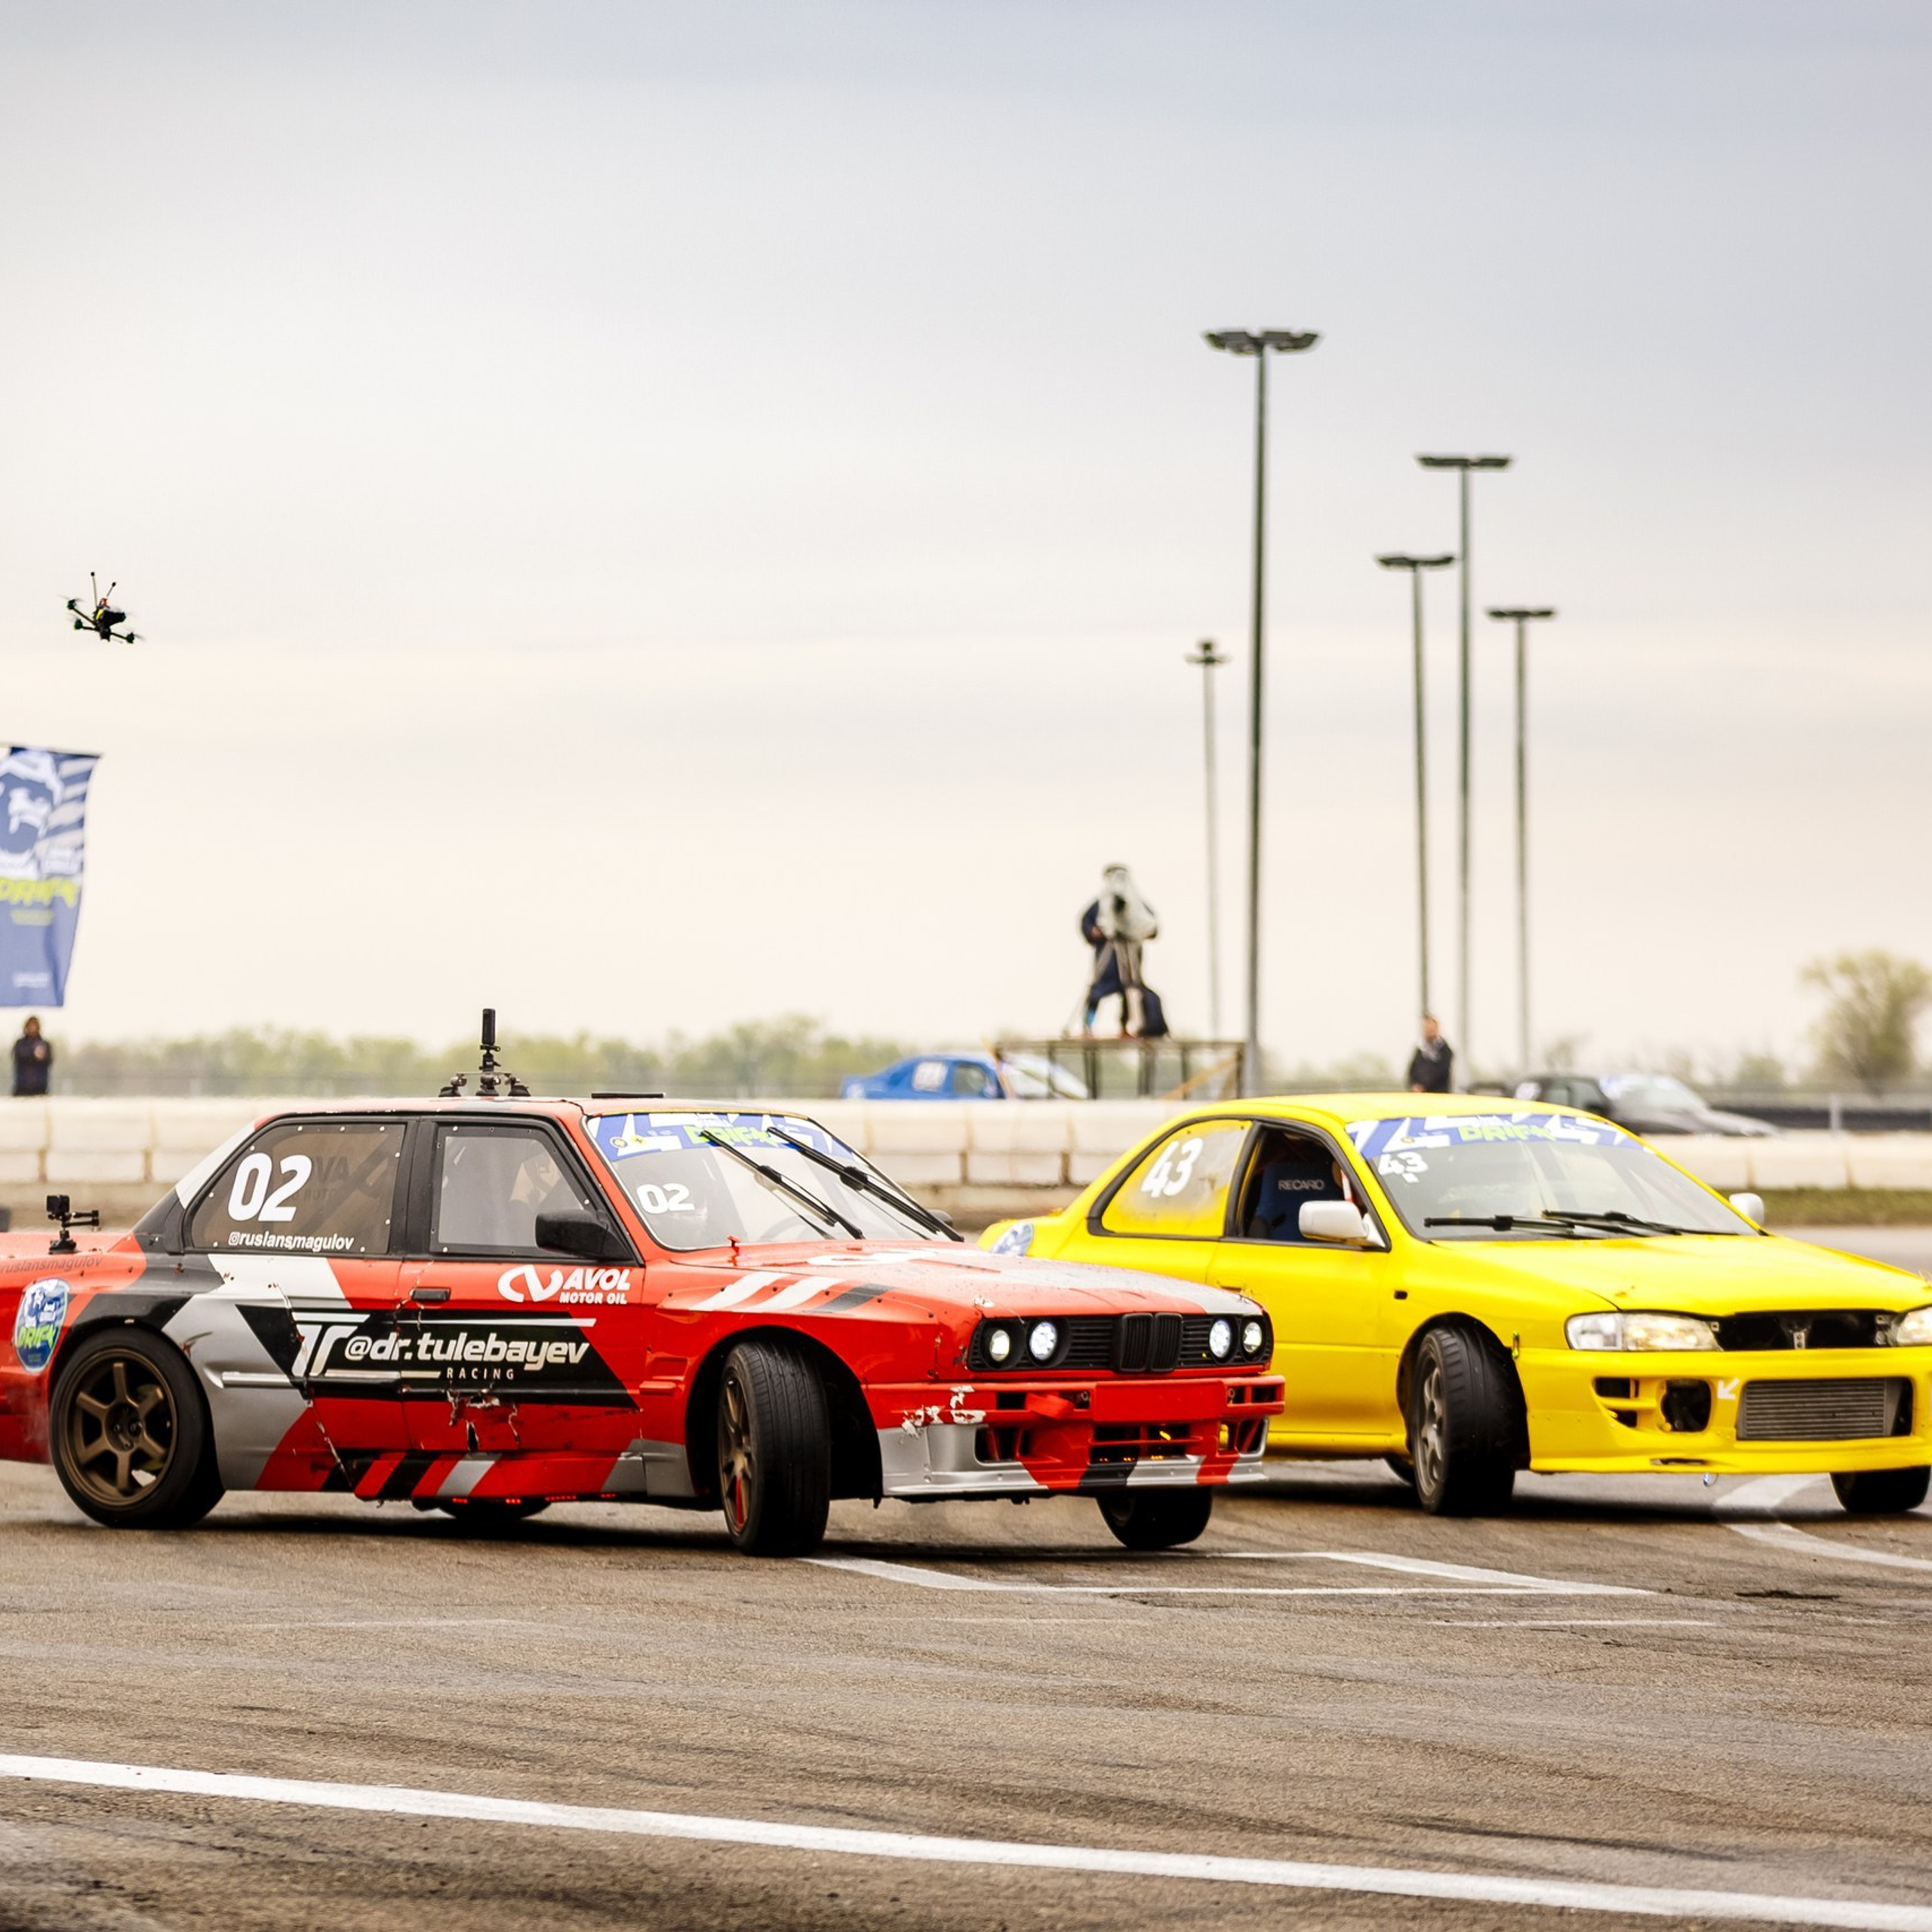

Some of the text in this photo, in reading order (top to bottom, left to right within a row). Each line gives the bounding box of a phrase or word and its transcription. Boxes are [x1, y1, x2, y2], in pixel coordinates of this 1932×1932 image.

[1141, 1137, 1203, 1198] 43
[1378, 1152, 1428, 1176] 43
[228, 1152, 312, 1221] 02
[1278, 1180, 1324, 1190] RECARO
[636, 1183, 695, 1214] 02
[563, 1269, 630, 1291] AVOL
[559, 1292, 627, 1304] MOTOR OIL
[345, 1331, 590, 1371] @dr.tulebayev
[447, 1367, 514, 1380] RACING
